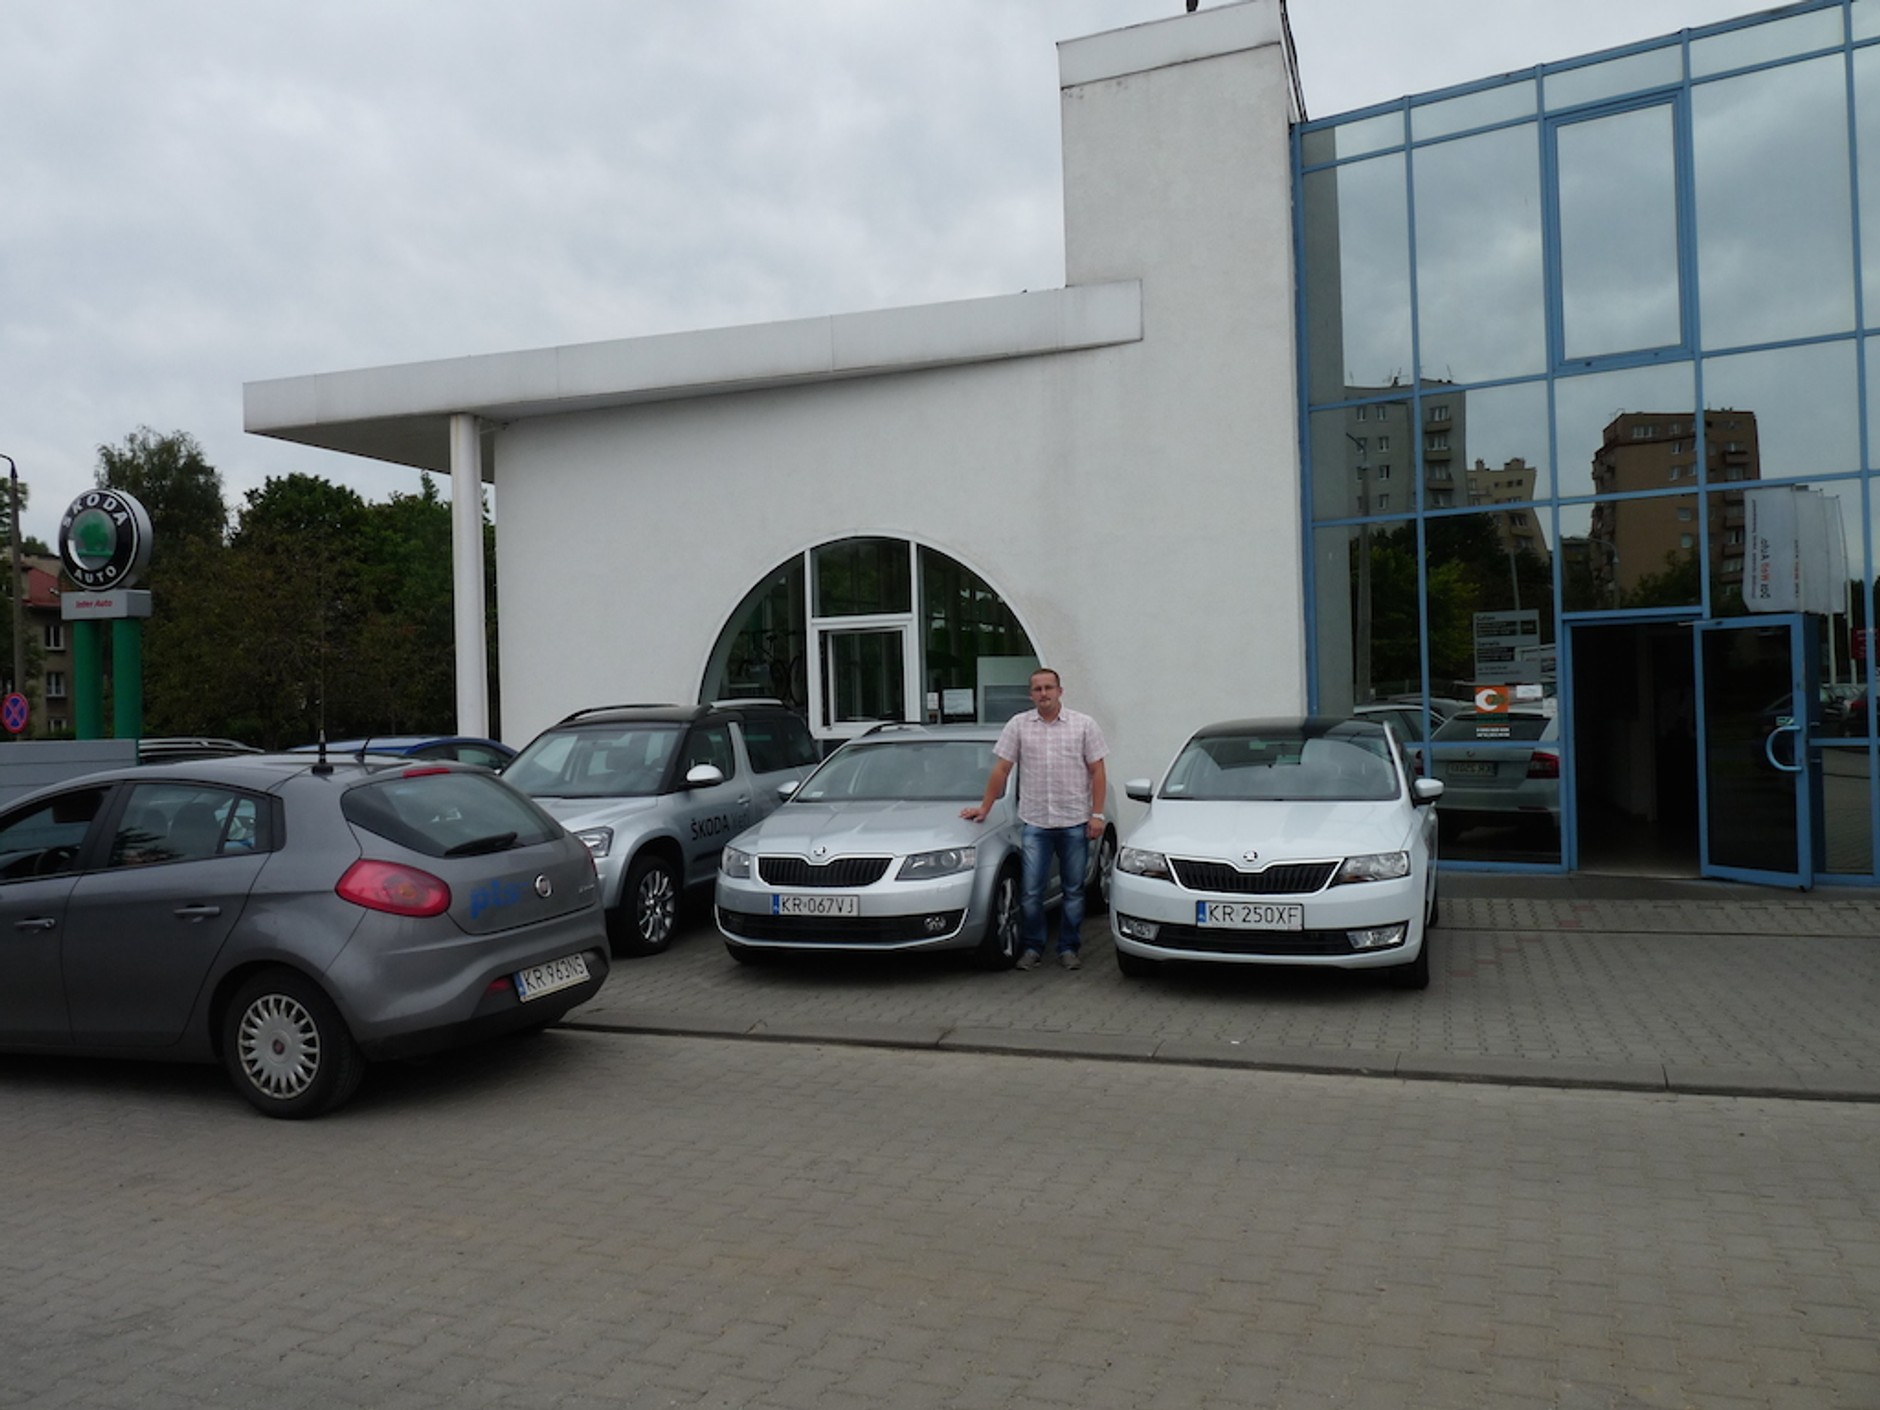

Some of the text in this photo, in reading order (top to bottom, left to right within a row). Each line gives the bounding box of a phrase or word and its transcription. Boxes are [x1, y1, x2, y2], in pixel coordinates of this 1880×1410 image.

[73, 565, 117, 582] AUTO
[690, 813, 730, 841] ŠKODA
[782, 897, 854, 914] KR 067VJ
[1208, 905, 1299, 924] KR 250XF
[523, 967, 547, 992] KR
